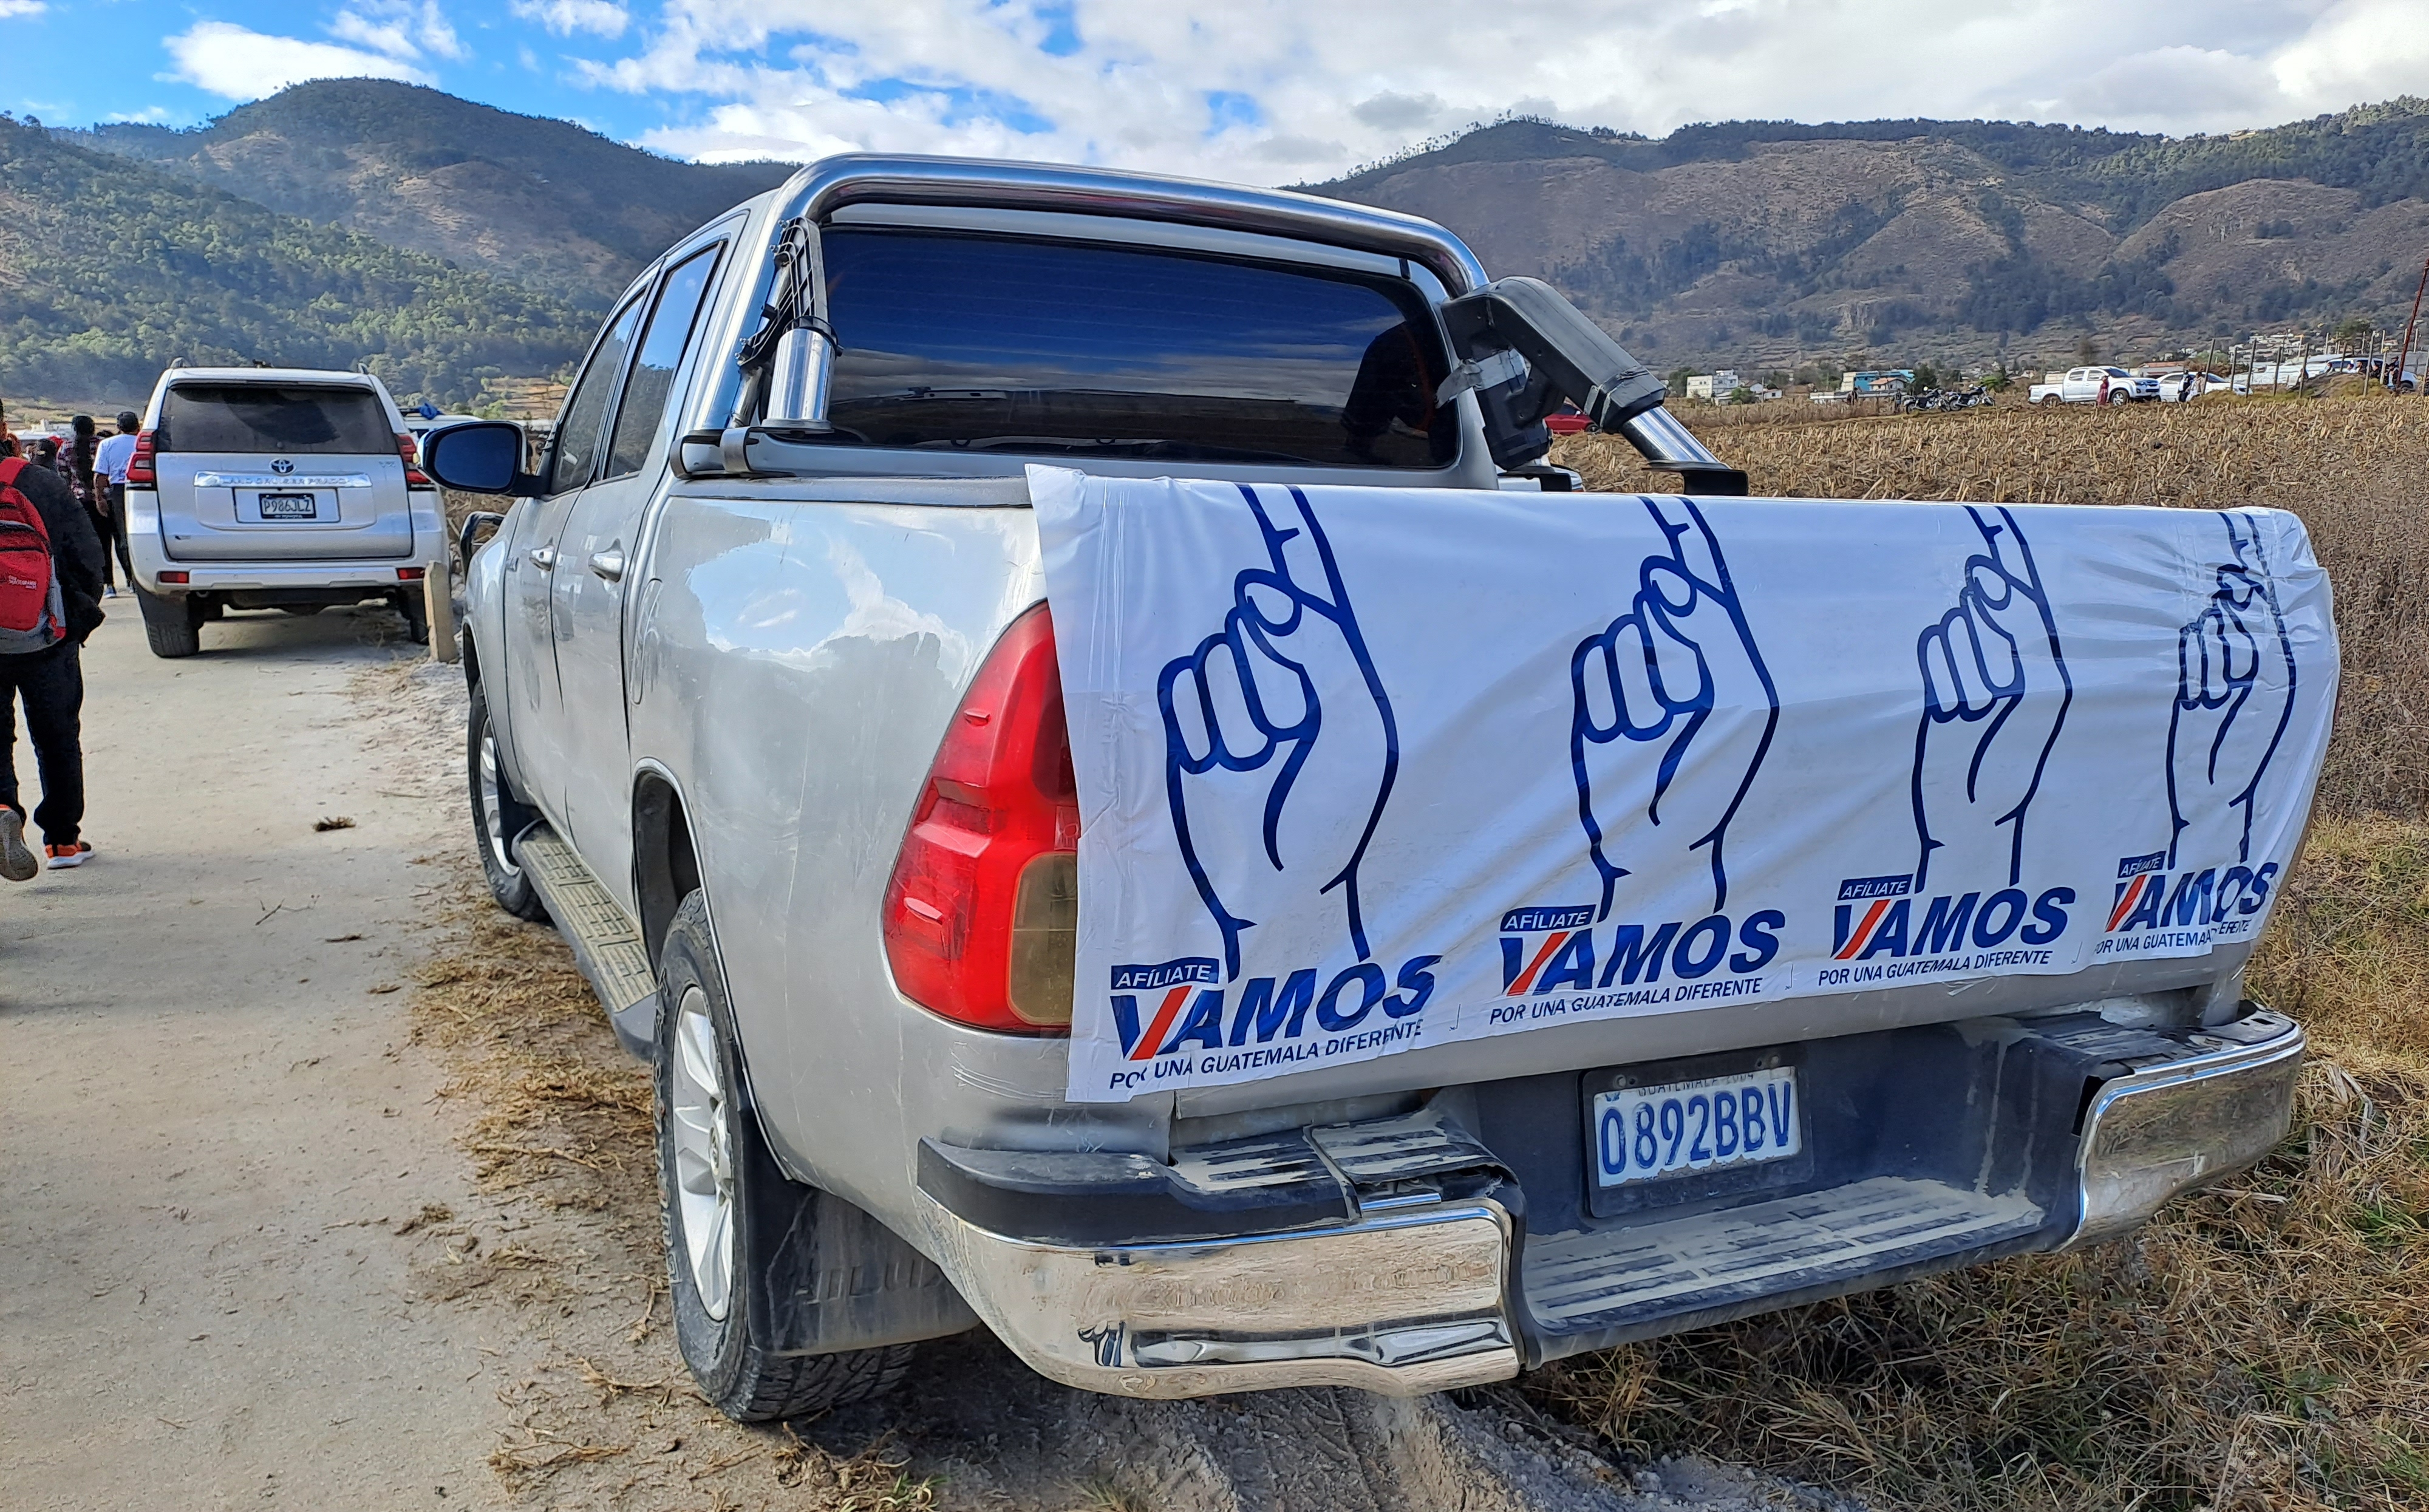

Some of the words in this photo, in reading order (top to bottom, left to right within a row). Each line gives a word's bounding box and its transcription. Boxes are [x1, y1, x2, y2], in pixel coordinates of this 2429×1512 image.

[1841, 880, 1907, 899] AFÍLIATE
[2105, 862, 2278, 932] VAMOS
[1504, 911, 1589, 930] AFÍLIATE
[1830, 887, 2076, 961] VAMOS
[1499, 909, 1786, 996] VAMOS
[2093, 939, 2113, 956] OR
[2116, 937, 2139, 952] UNA
[2143, 930, 2212, 950] GUATEMAA
[1116, 964, 1212, 988] AFÍLIATE
[1818, 969, 1850, 986] POR
[1853, 965, 1882, 982] UNA
[1886, 956, 1971, 978] GUATEMALA
[1973, 950, 2053, 969] DIFERENTE
[1109, 955, 1443, 1061] VAMOS
[1490, 1004, 1526, 1025] POR
[1531, 998, 1566, 1019] UNA
[1571, 987, 1670, 1012] GUATEMALA
[1675, 978, 1763, 1002] DIFERENTE
[1154, 1056, 1193, 1079] UNA
[1201, 1042, 1319, 1074] GUATEMALA
